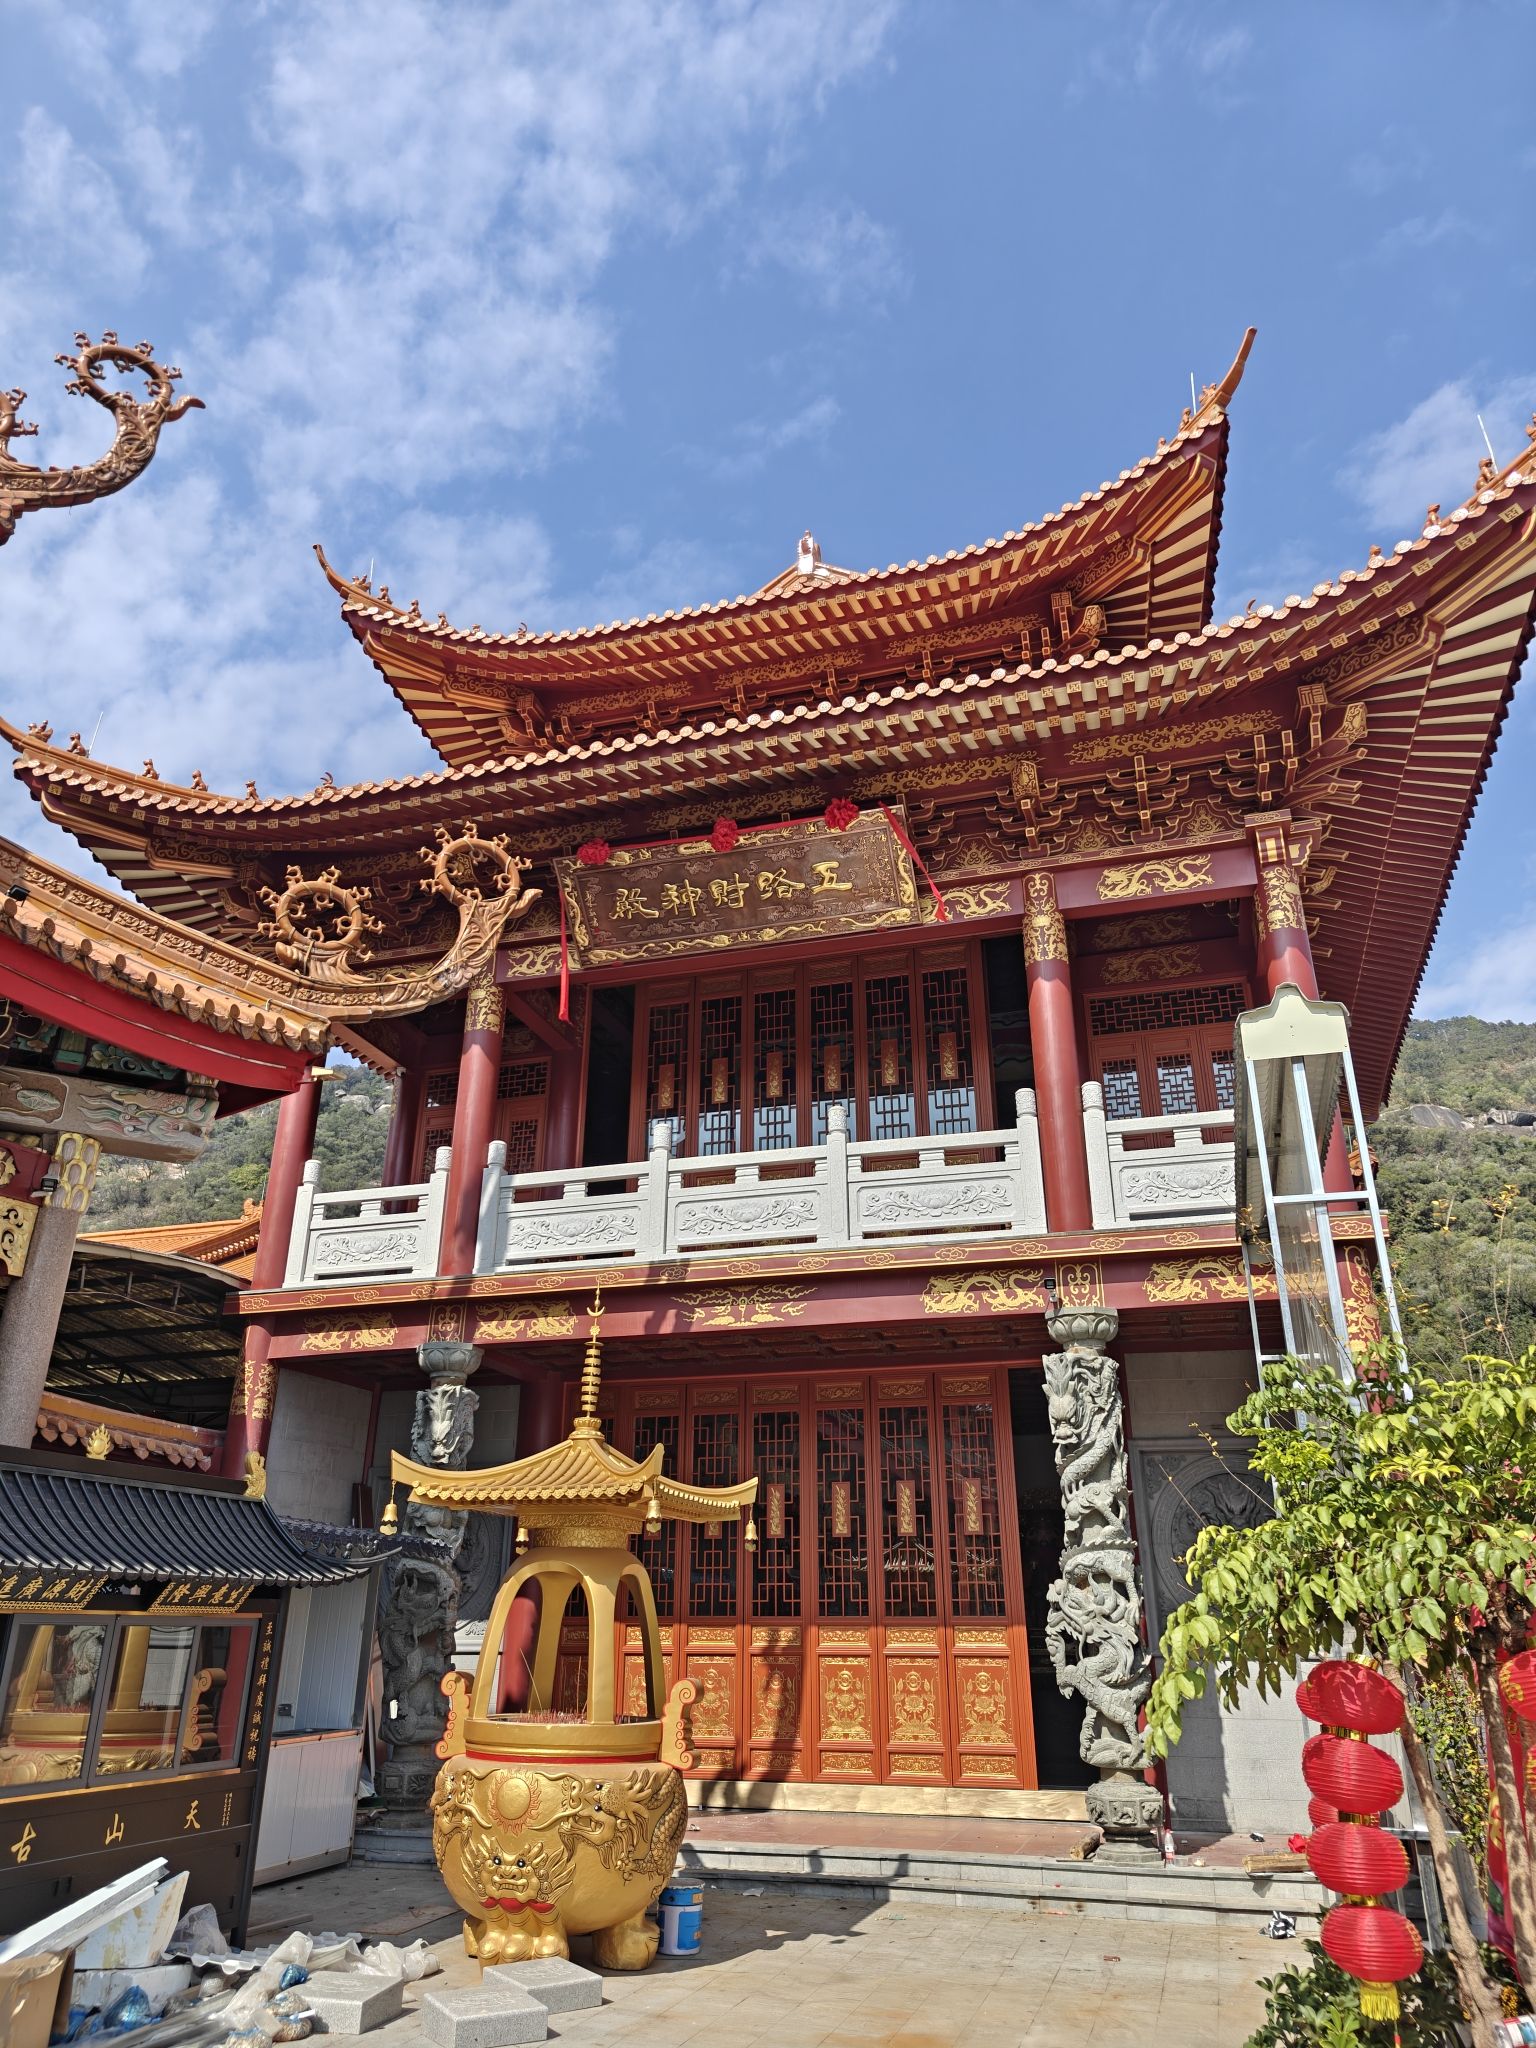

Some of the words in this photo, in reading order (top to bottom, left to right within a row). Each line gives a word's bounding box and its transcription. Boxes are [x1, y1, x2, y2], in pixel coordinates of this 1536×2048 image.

[1300, 685, 1325, 705] 福
[609, 861, 853, 919] 五路財神殿
